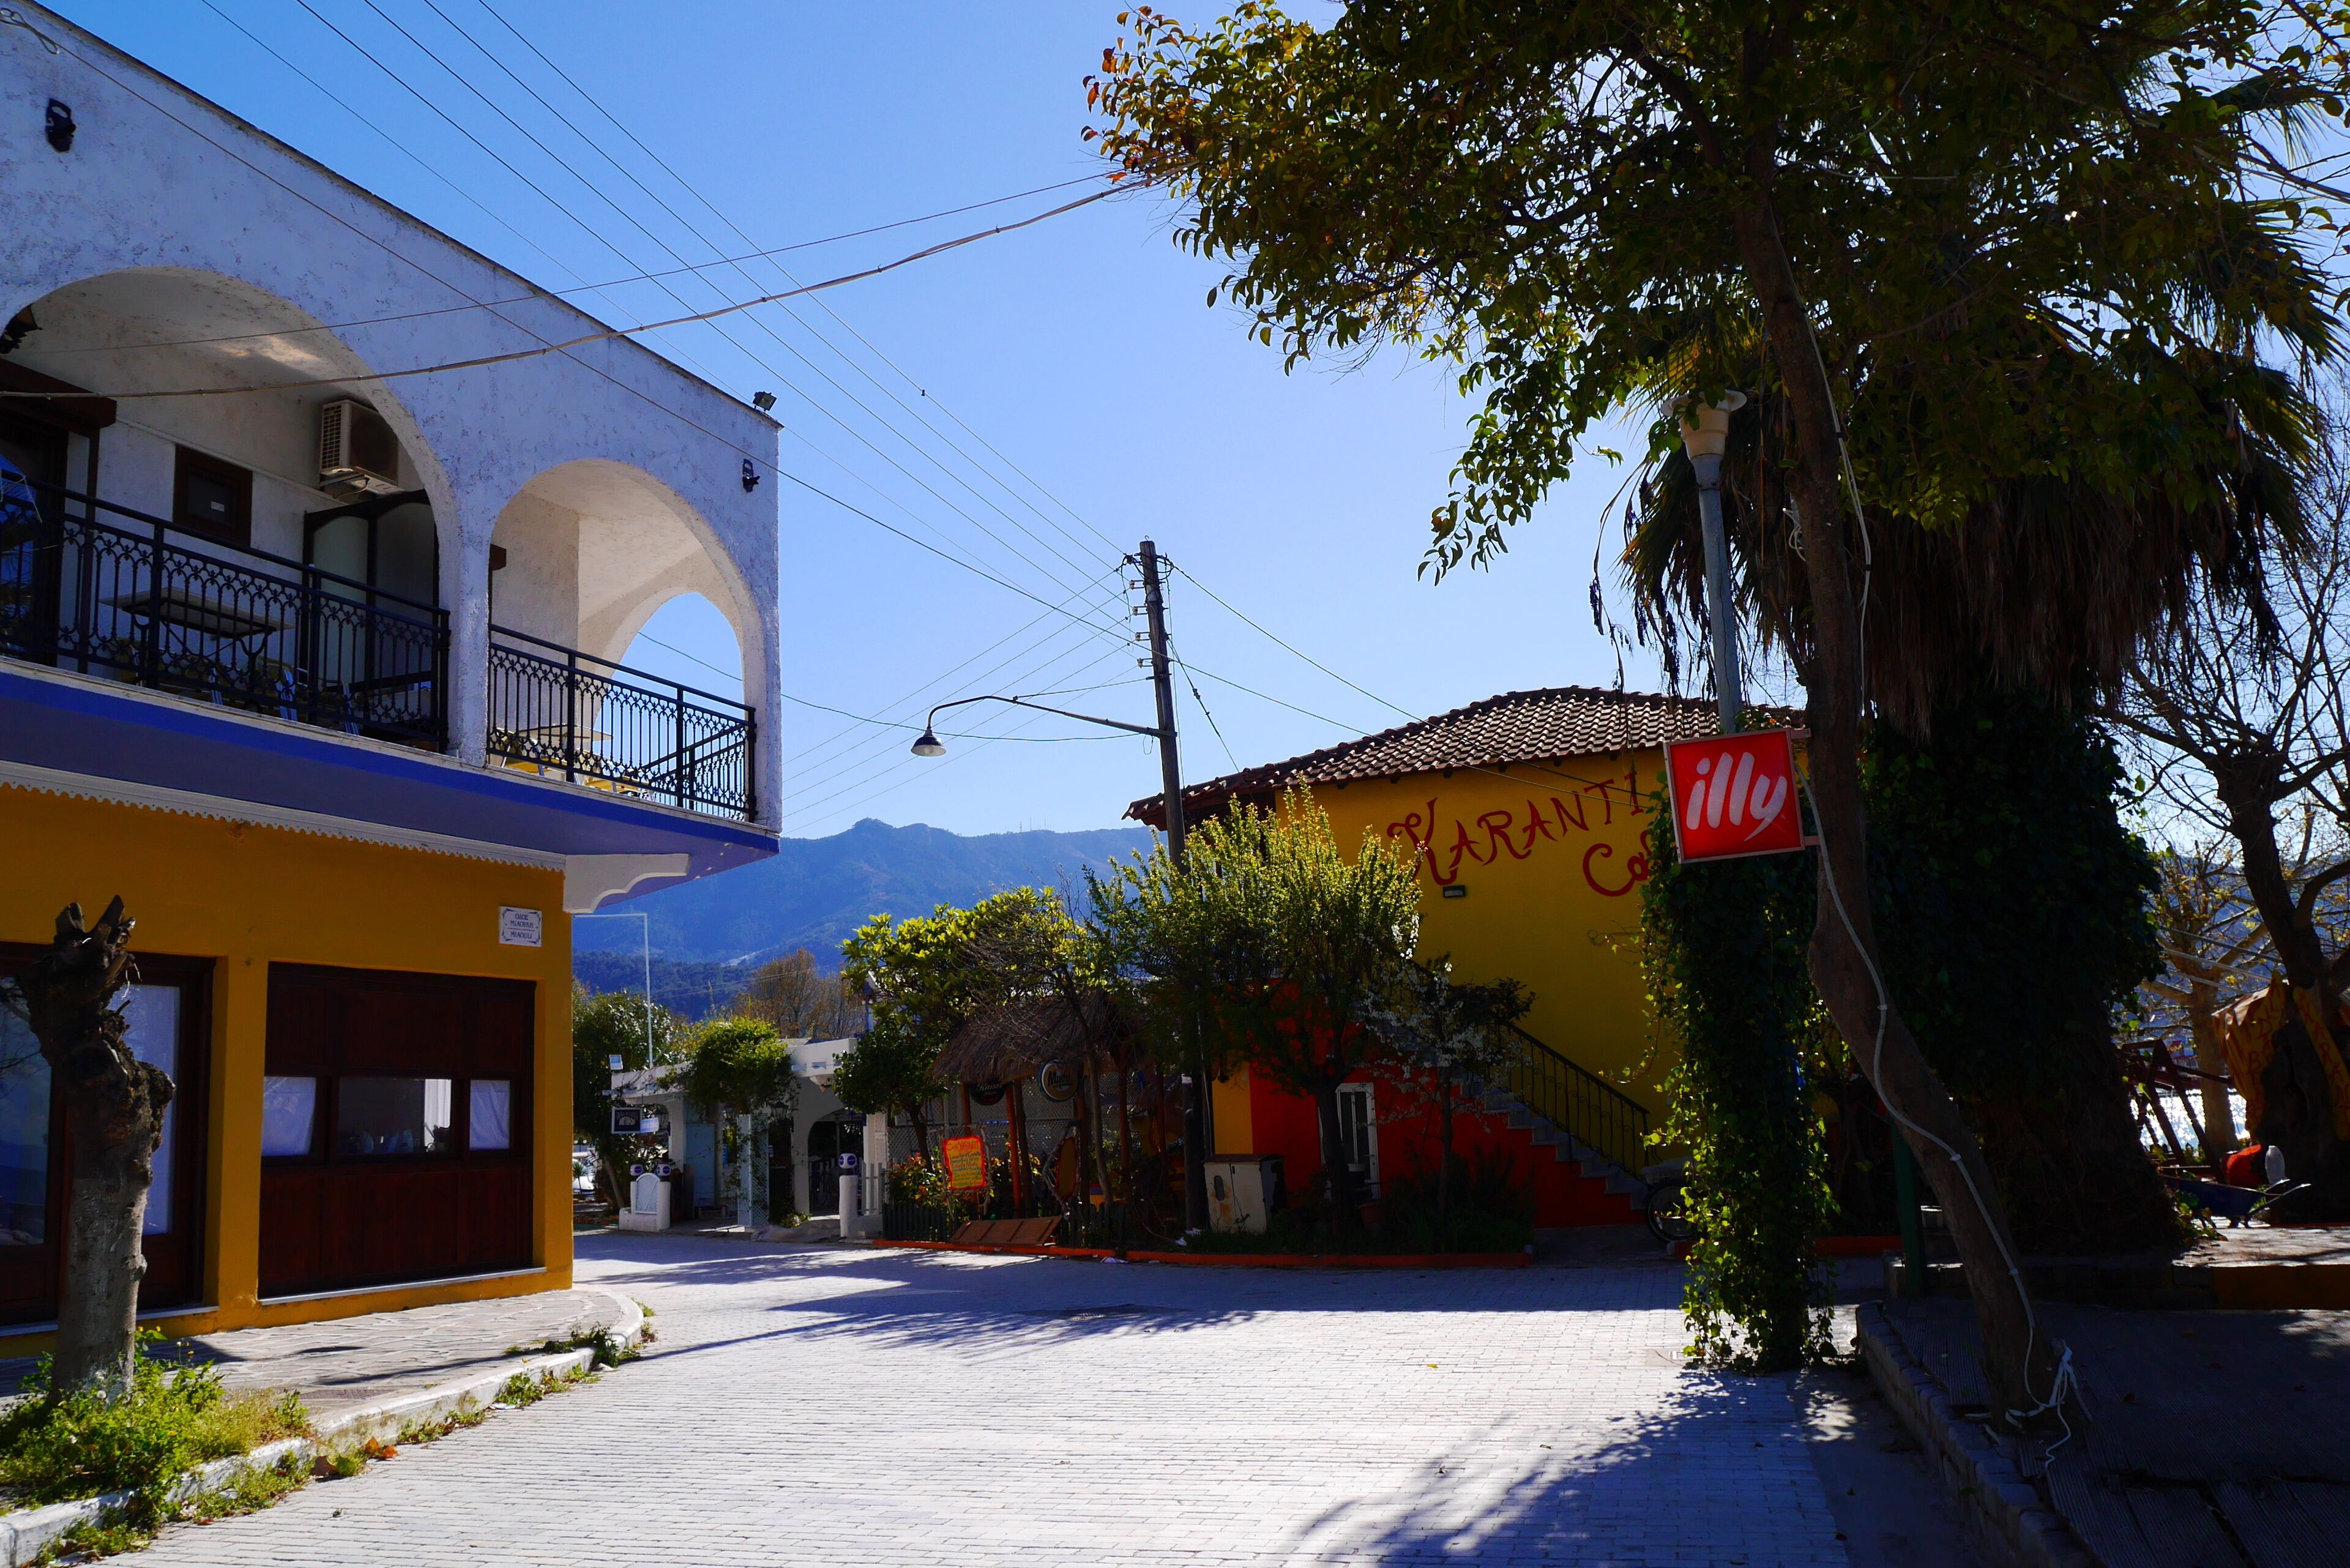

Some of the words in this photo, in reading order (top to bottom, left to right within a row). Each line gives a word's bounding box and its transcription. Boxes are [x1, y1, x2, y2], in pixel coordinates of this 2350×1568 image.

[1387, 771, 1644, 886] KARANTI
[1686, 752, 1788, 842] illy
[510, 920, 534, 928] ΜΙΑΟΥΛΗ
